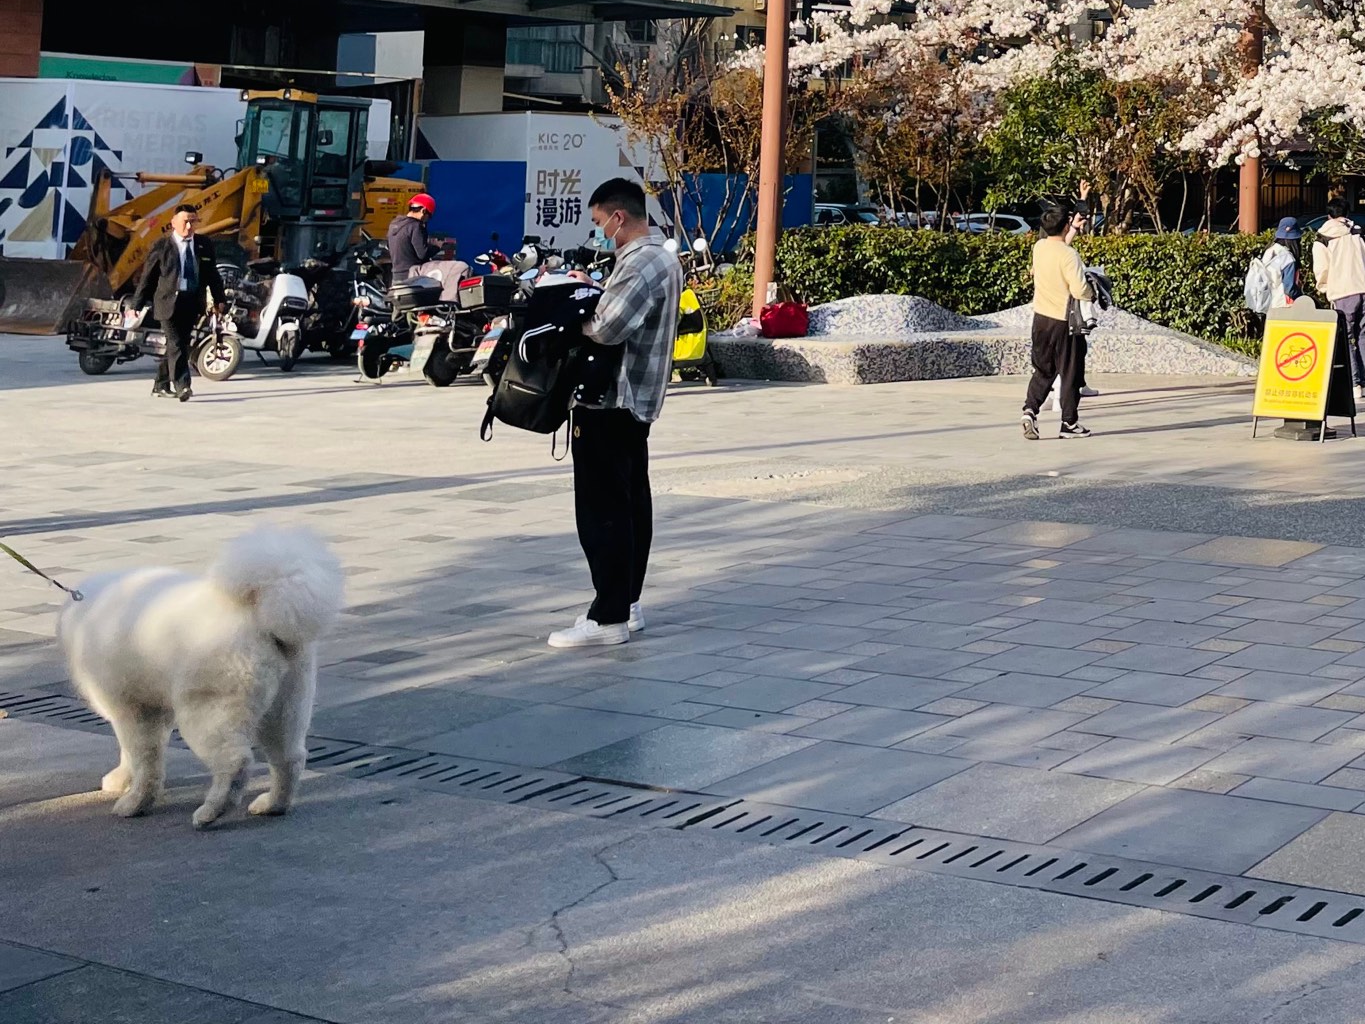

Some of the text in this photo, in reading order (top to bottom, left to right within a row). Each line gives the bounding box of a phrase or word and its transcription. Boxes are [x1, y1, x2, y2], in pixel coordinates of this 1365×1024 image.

[538, 133, 559, 145] KIC
[536, 169, 581, 196] 时光
[536, 197, 581, 228] 漫游
